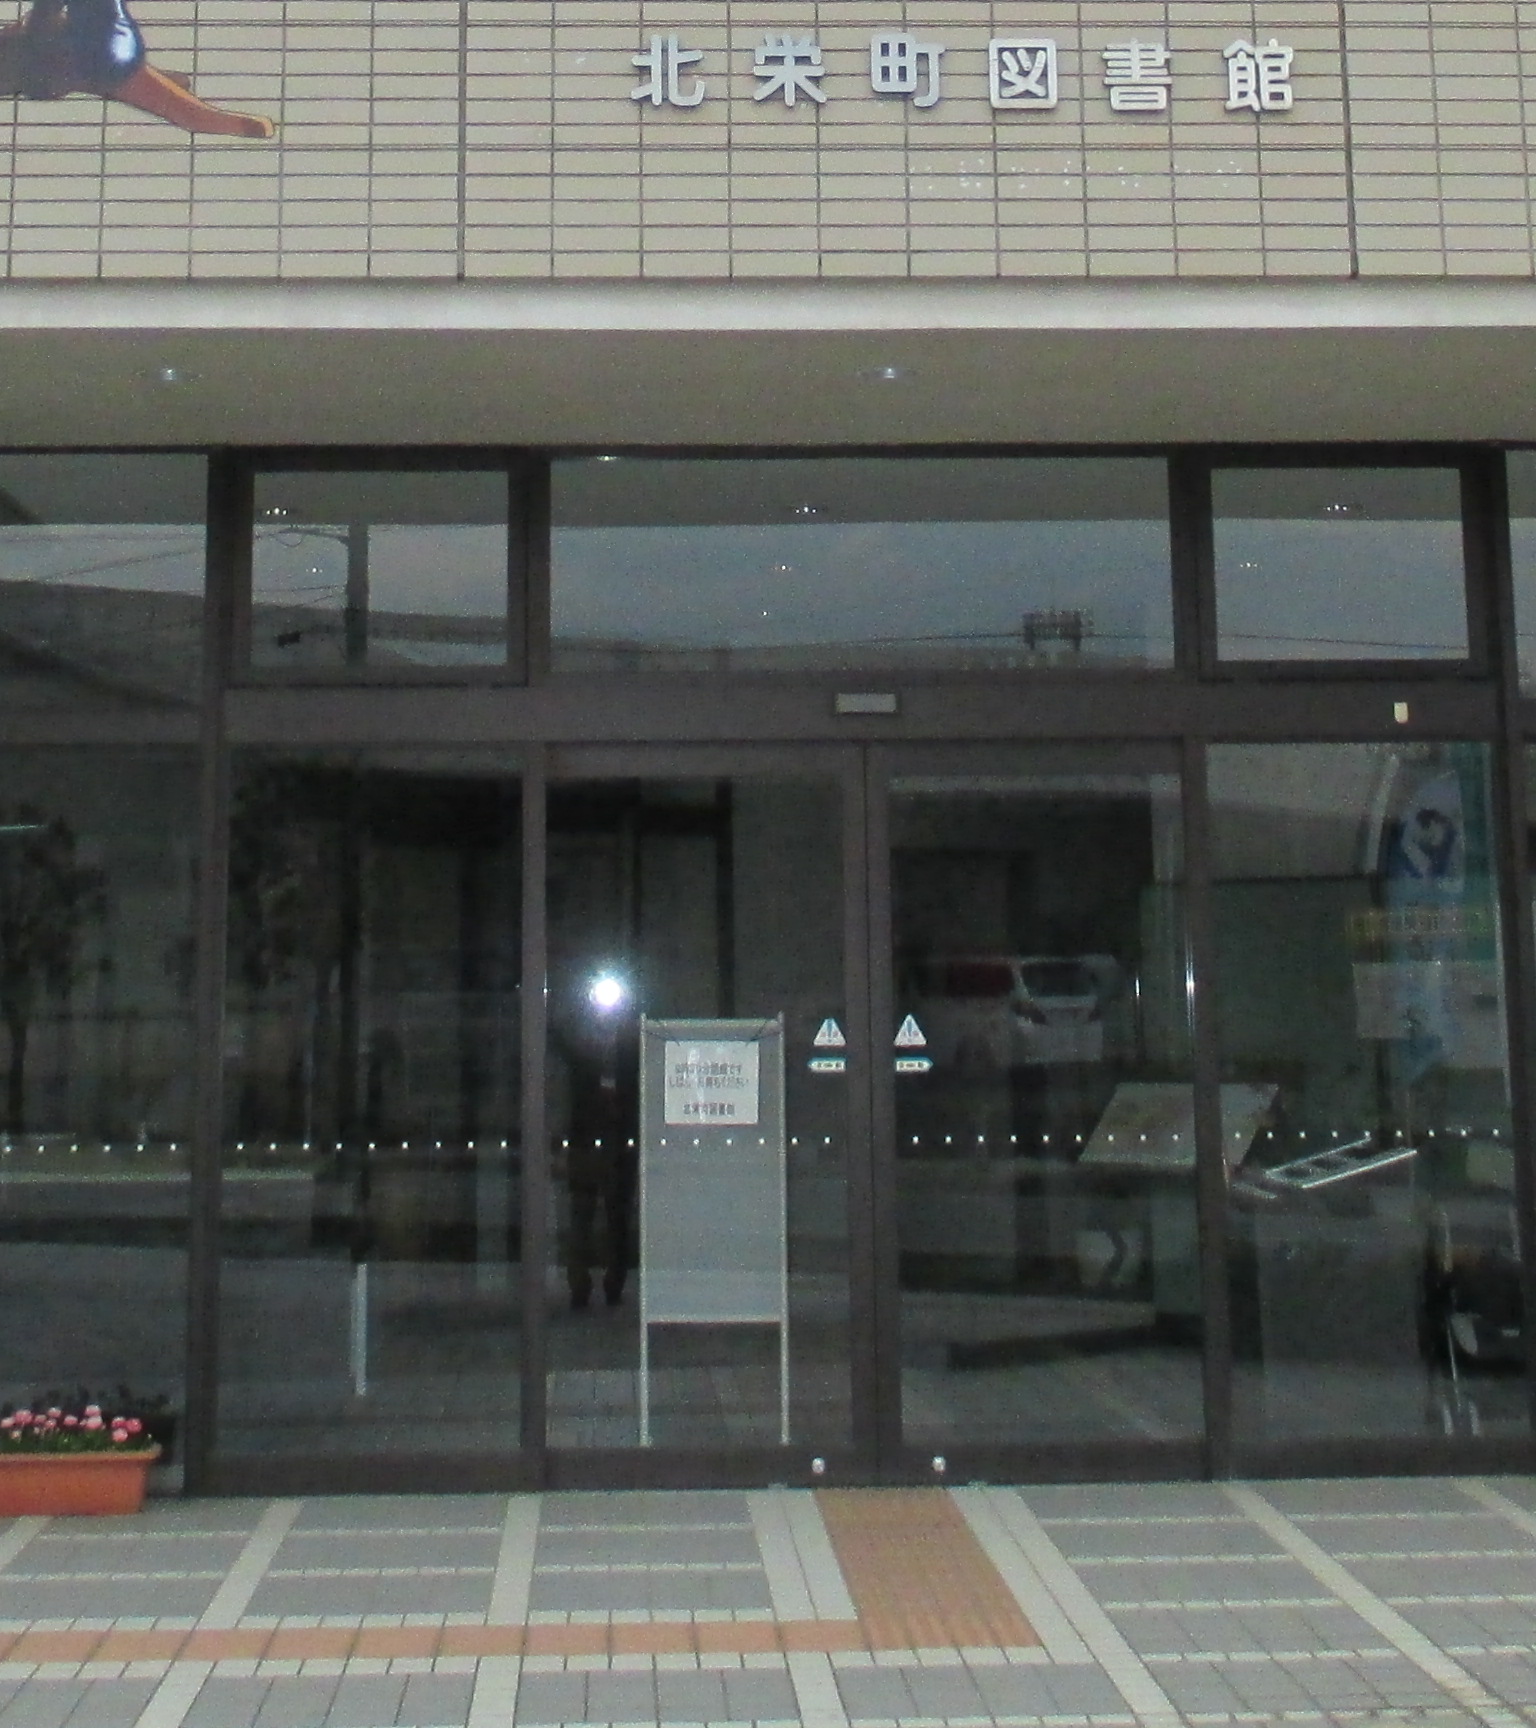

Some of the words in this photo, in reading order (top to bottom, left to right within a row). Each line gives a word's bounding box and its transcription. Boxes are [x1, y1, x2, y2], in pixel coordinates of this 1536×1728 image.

[630, 33, 1294, 112] 北栄町図書館
